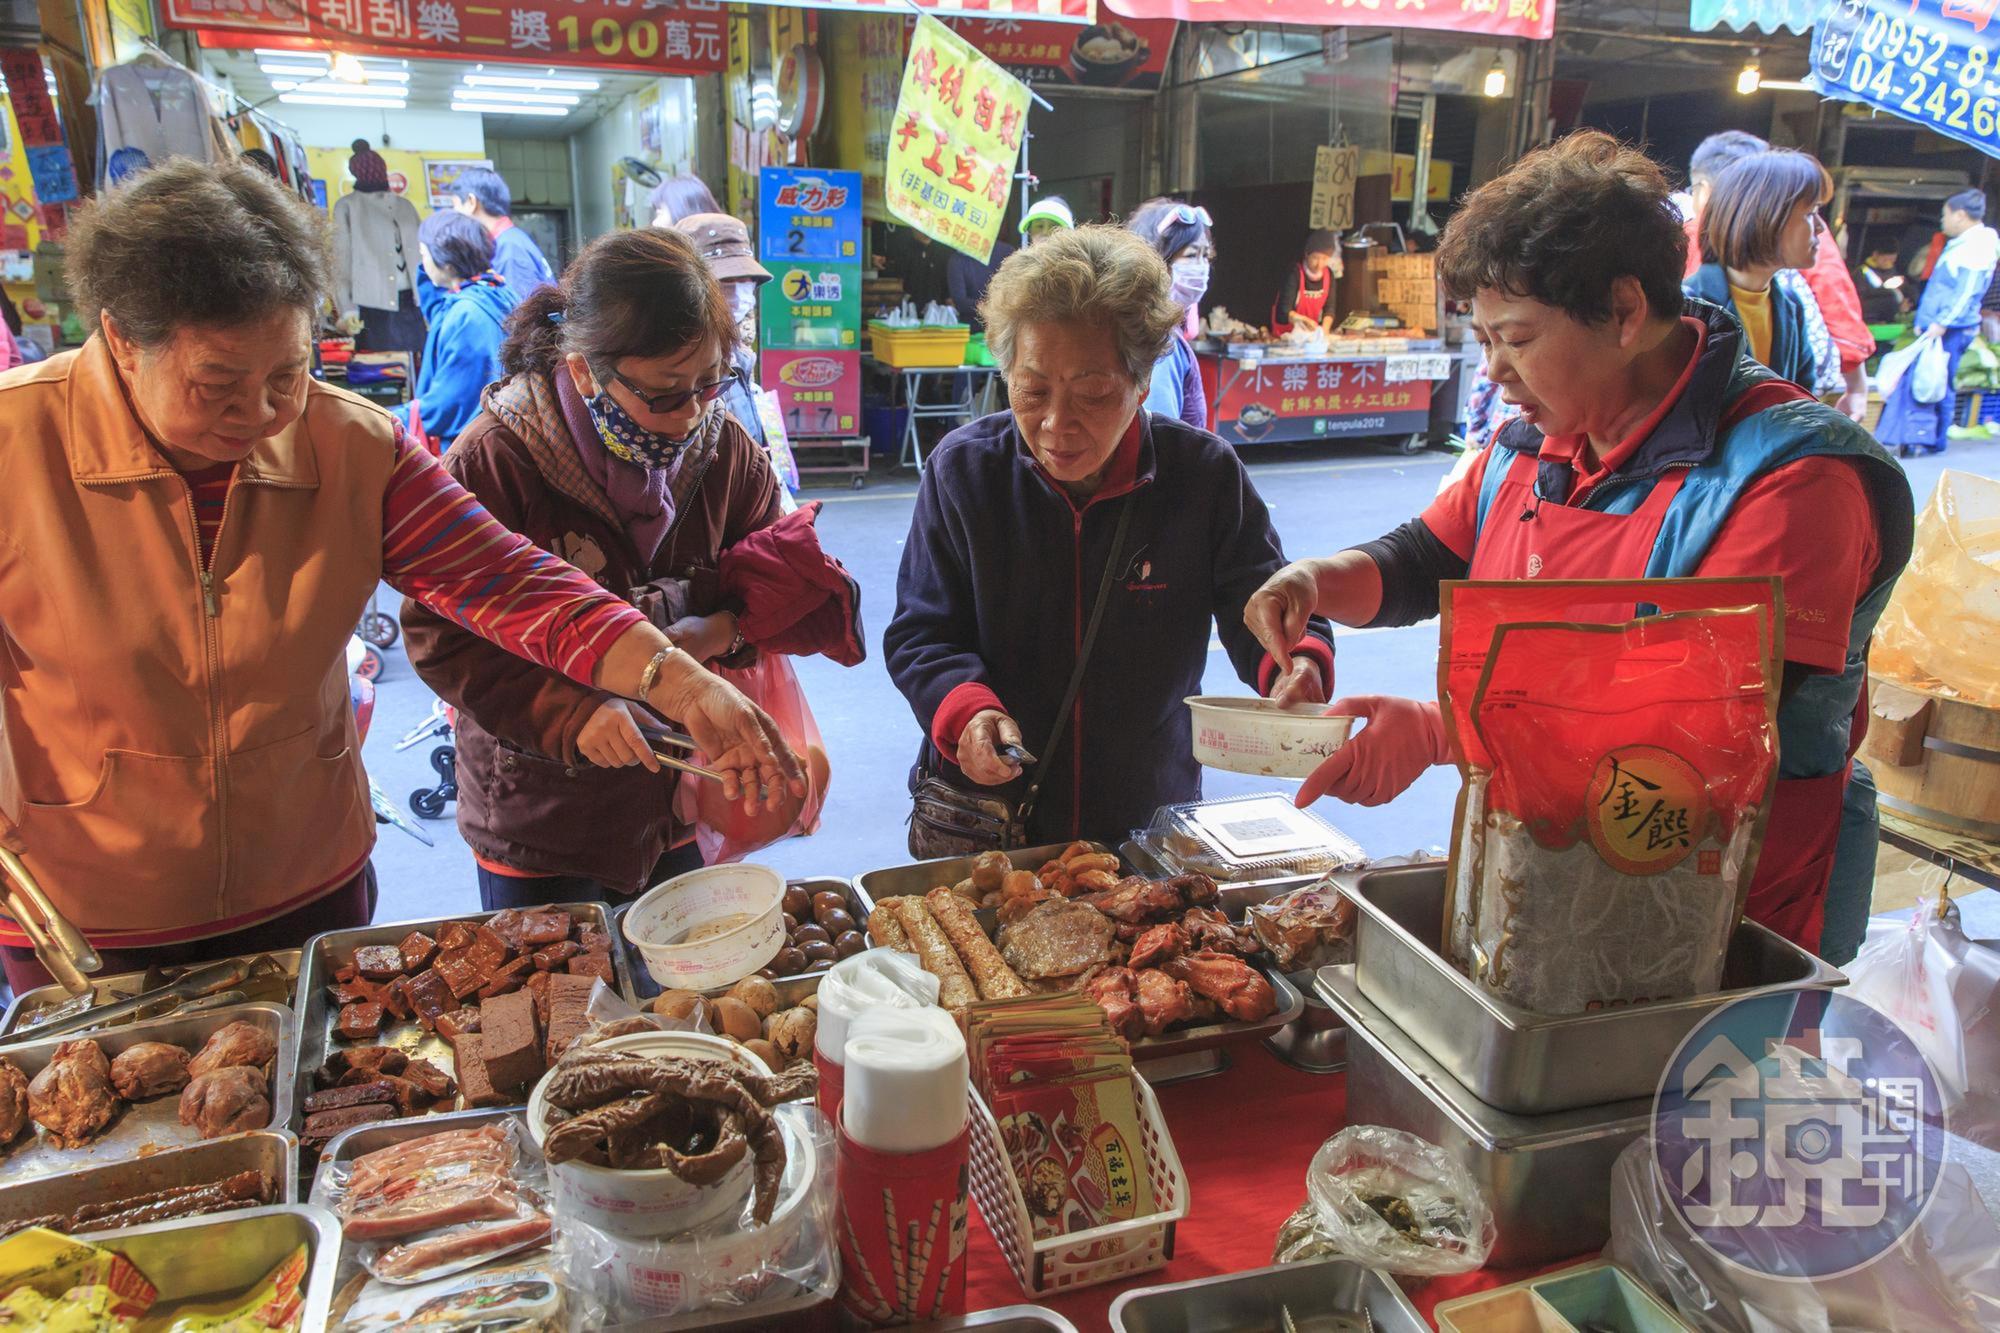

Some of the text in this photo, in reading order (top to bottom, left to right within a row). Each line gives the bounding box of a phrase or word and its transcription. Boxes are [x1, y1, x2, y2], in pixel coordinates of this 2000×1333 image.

[1850, 52, 2000, 138] 04-2426
[896, 110, 1008, 209] 手工豆腐
[776, 186, 848, 212] 威力彩
[788, 230, 804, 253] 2
